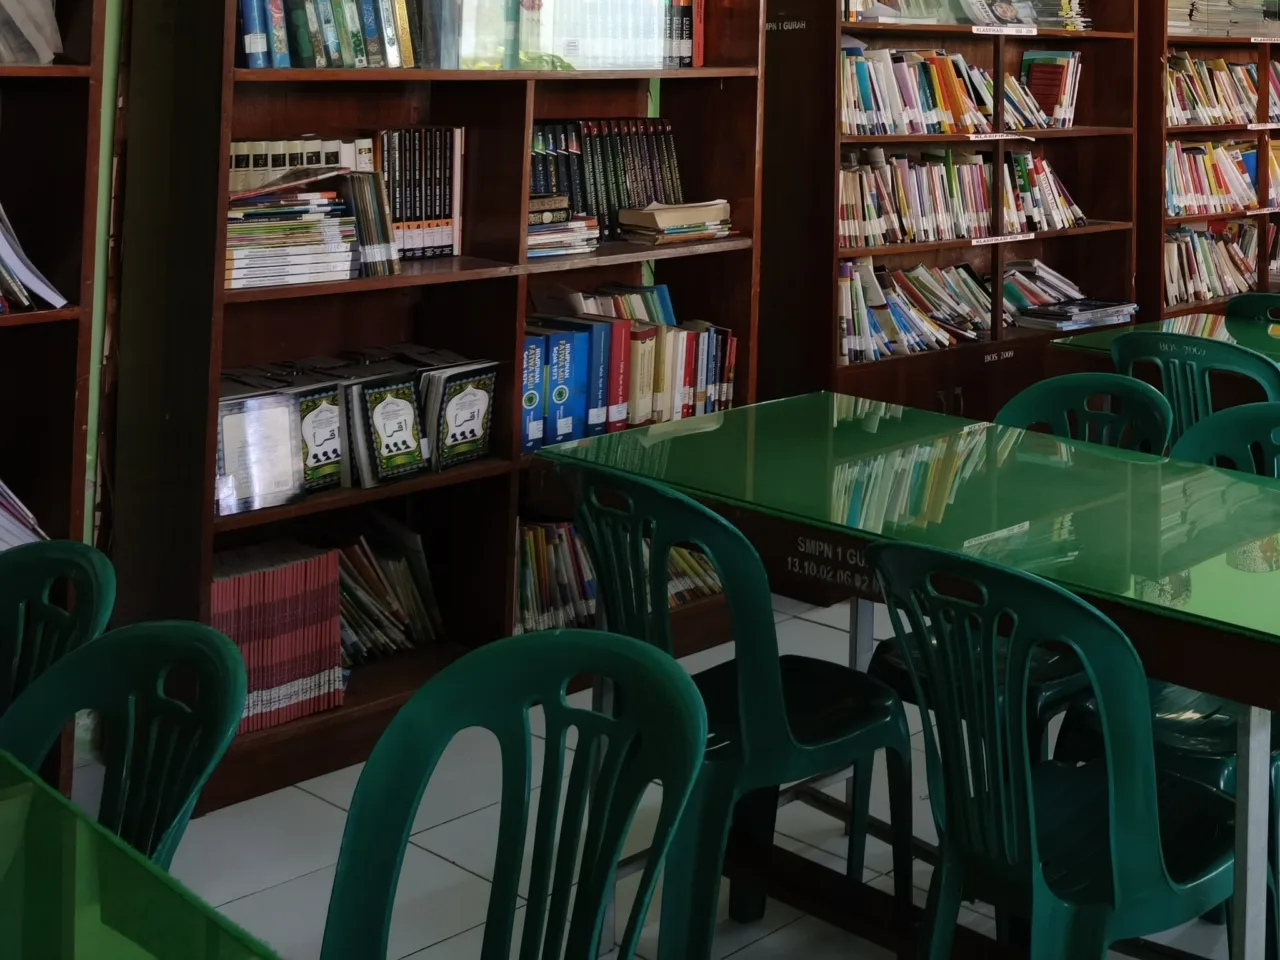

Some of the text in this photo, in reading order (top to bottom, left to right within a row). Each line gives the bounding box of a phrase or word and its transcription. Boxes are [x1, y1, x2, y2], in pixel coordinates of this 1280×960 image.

[783, 21, 806, 30] GURAH
[1000, 350, 1014, 360] 2009
[797, 536, 868, 567] SMPN 1 GU
